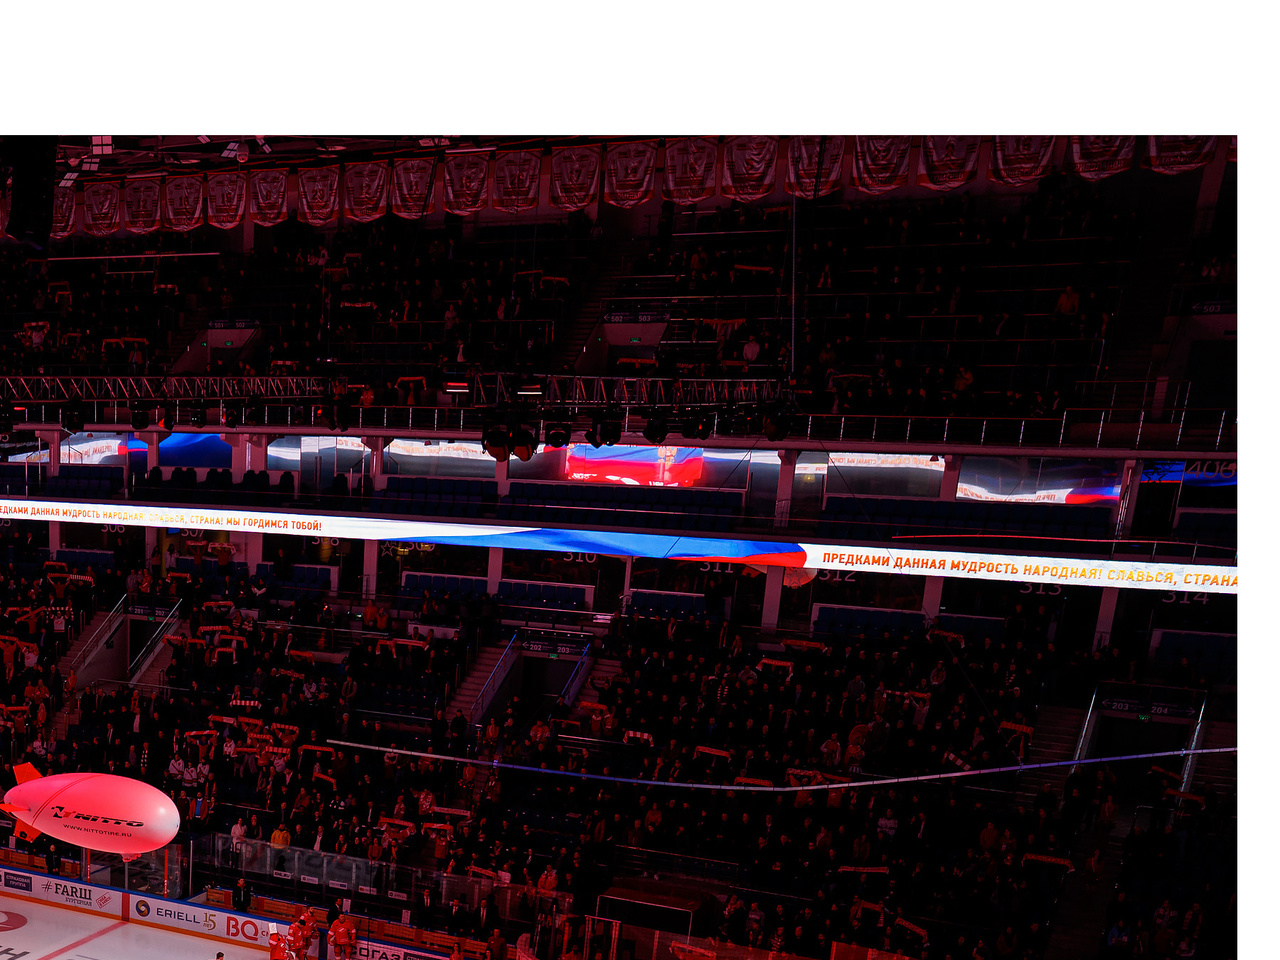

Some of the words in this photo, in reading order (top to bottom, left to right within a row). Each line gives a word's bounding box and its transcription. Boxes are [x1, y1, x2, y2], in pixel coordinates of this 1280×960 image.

[1184, 460, 1237, 479] 406
[31, 507, 60, 516] ДАННАЯ
[61, 508, 101, 519] МУДРОСТЬ
[102, 510, 146, 521] НАРОДНАЯ!
[190, 515, 223, 526] СТРАНА!
[226, 516, 240, 526] МЫ
[243, 517, 288, 529] ГОРДИМСЯ
[291, 519, 322, 531] ТОБОЙ!
[823, 553, 890, 567] ПРЕДКАМИ
[893, 556, 947, 570] ДАННАЯ
[950, 560, 1019, 575] МУДРОСТЬ
[1023, 564, 1102, 580] НАРОДНАЯ!
[1107, 569, 1178, 586] СЛАВЬСЯ,
[1111, 702, 1129, 711] 203
[1151, 706, 1168, 714] 204
[73, 812, 144, 827] NITTO
[63, 823, 132, 837] WWW.NITTOTIRE.RU
[5, 873, 32, 885] СТРАХОВАЯ
[9, 879, 29, 889] ГРУППА
[156, 907, 201, 924] ERIELL
[203, 912, 216, 924] 15
[225, 916, 259, 941] BQ
